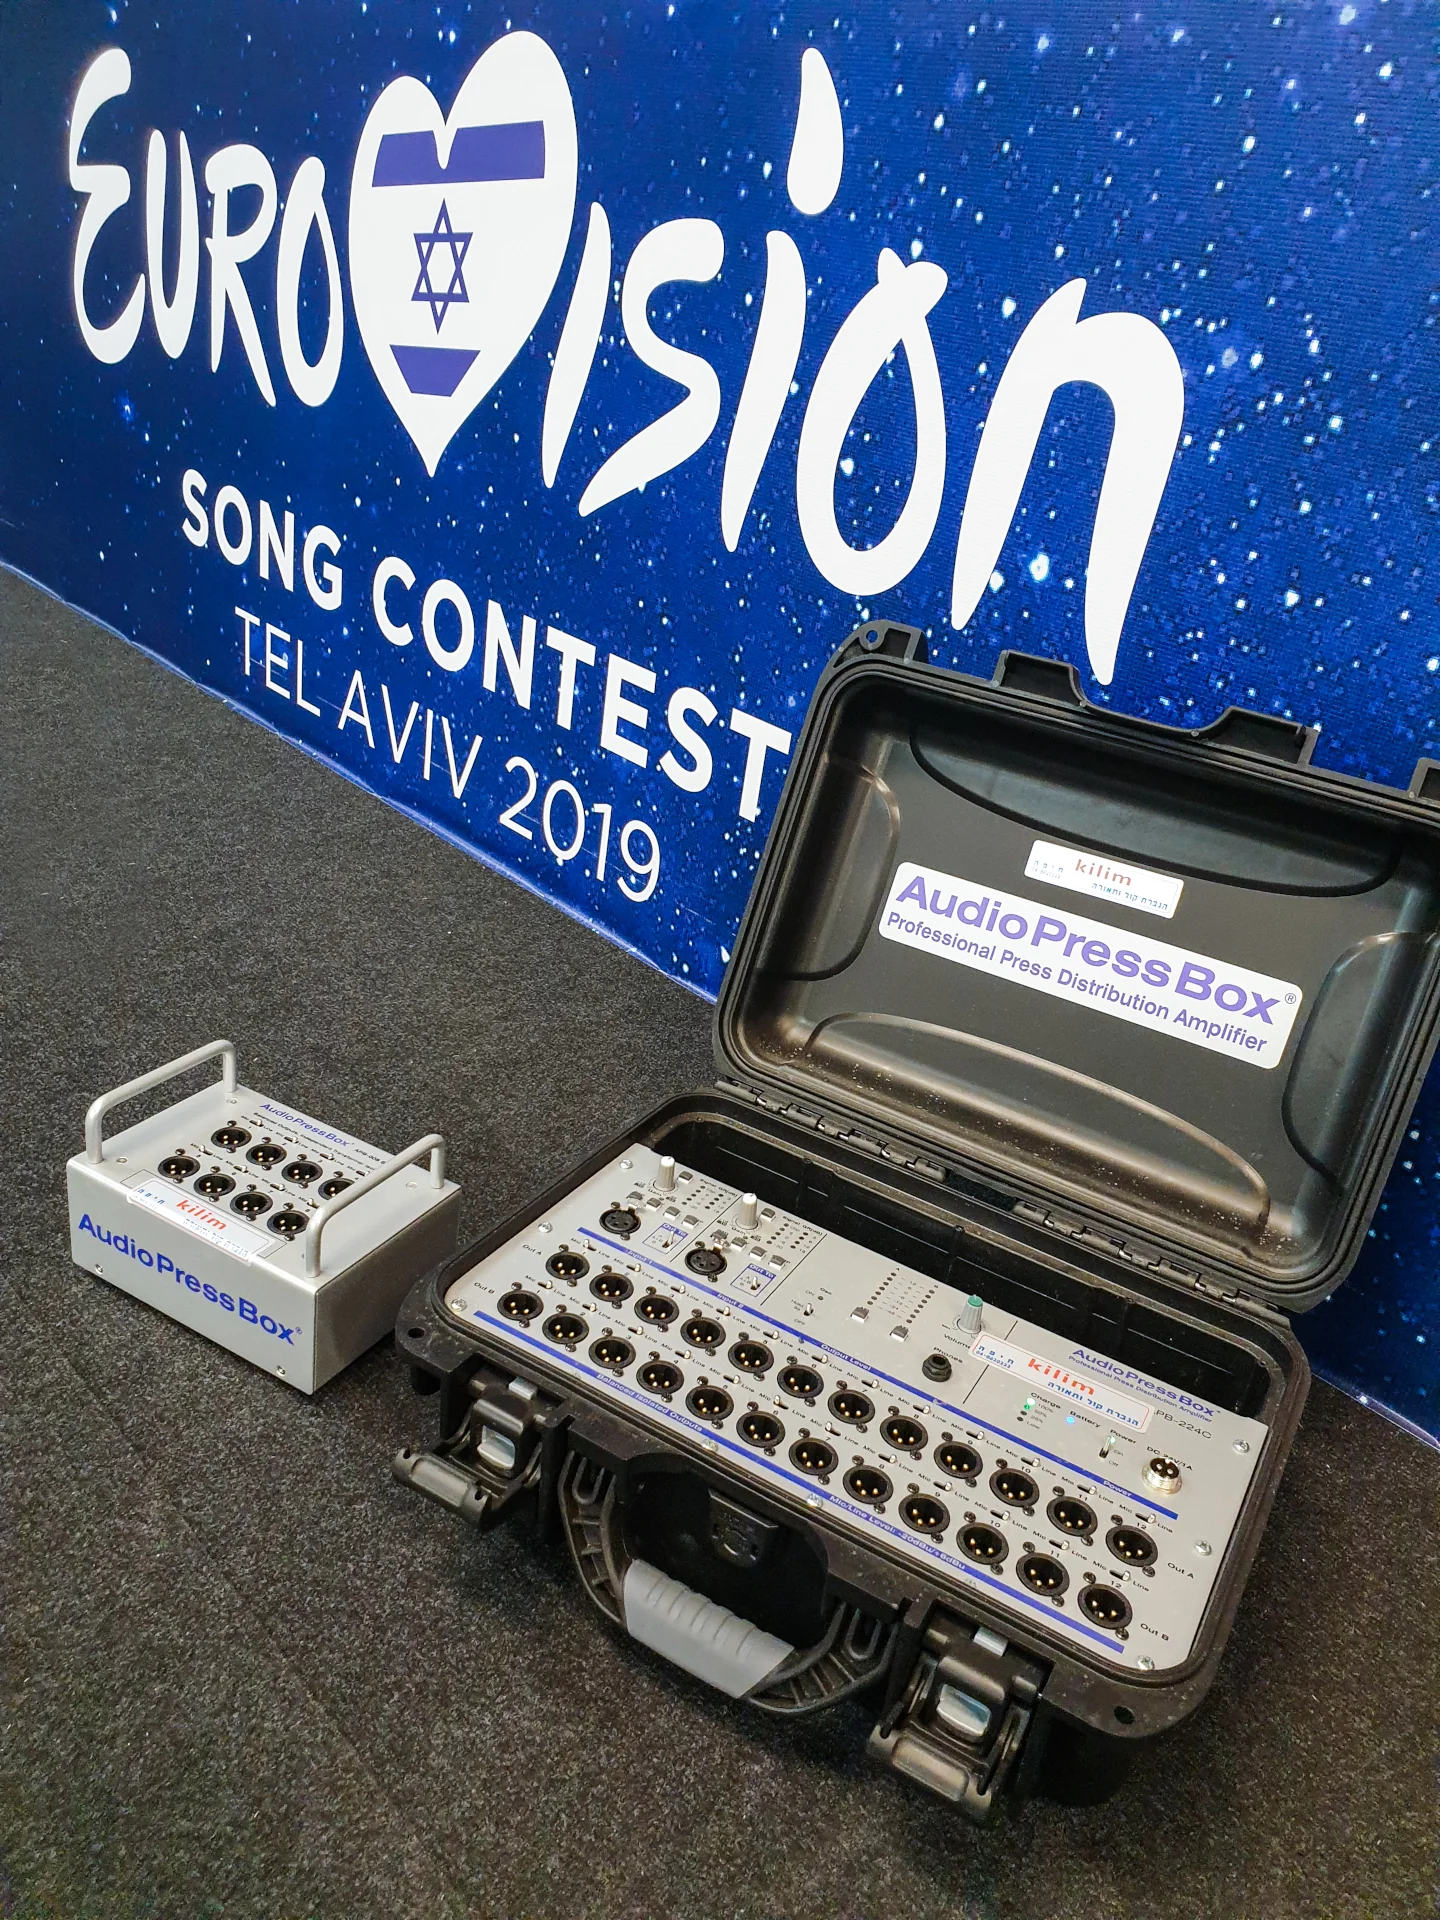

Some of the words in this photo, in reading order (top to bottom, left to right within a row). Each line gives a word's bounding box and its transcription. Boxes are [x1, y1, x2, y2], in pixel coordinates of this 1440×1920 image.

[181, 468, 342, 611] SONG
[373, 556, 792, 823] CONTEST
[235, 606, 321, 716] TEL
[338, 670, 482, 799] AVIV
[499, 756, 660, 903] 2019
[1075, 859, 1132, 886] kilim
[887, 912, 996, 961] Professional
[1000, 950, 1052, 980] Press
[1057, 968, 1170, 1020] Distribution
[1173, 1008, 1268, 1052] Amplifier
[176, 1199, 226, 1230] kilim
[522, 1244, 535, 1252] Out
[598, 1251, 610, 1259] Line
[524, 1275, 536, 1283] Mic
[474, 1282, 487, 1290] Out
[553, 1289, 566, 1297] Line
[687, 1293, 699, 1301] Line
[569, 1297, 581, 1305] Mic
[702, 1301, 714, 1309] Mic
[598, 1311, 611, 1320] Line
[733, 1316, 746, 1324] Line
[614, 1319, 626, 1327] Mic
[749, 1324, 761, 1332] Mic
[644, 1335, 658, 1343] Line
[661, 1343, 673, 1351] Mic
[780, 1340, 793, 1348] Line
[797, 1348, 809, 1356] Mic
[934, 1347, 963, 1363] Phones
[821, 1343, 849, 1361] Output
[850, 1357, 871, 1371] Level
[692, 1359, 706, 1368] Line
[829, 1364, 843, 1372] Line
[709, 1367, 721, 1375] Mic
[846, 1372, 859, 1380] Mic
[1028, 1358, 1095, 1395] kilim
[741, 1384, 755, 1393] Line
[880, 1388, 894, 1398] Line
[1068, 1355, 1112, 1381] Professional
[1113, 1376, 1134, 1388] Press
[1136, 1386, 1177, 1408] Distribution
[1179, 1406, 1212, 1423] Amplifier
[759, 1392, 771, 1401] Mic
[1031, 1392, 1061, 1409] Charge
[596, 1374, 634, 1398] Balanced
[635, 1392, 668, 1415] Isolated
[669, 1411, 703, 1432] Outputs
[898, 1397, 910, 1406] Mic
[1087, 1399, 1103, 1410] קול
[792, 1410, 806, 1419] Line
[932, 1414, 947, 1423] Line
[1070, 1410, 1101, 1428] Battery
[810, 1419, 822, 1427] Mic
[951, 1423, 964, 1432] Mic
[1154, 1409, 1212, 1440] PB-224C
[844, 1436, 859, 1445] Line
[1109, 1429, 1137, 1444] Power
[863, 1445, 876, 1454] Mic
[986, 1440, 1001, 1450] Line
[1005, 1449, 1019, 1458] Mic
[1146, 1446, 1160, 1455] DC
[898, 1463, 914, 1473] Line
[1041, 1467, 1057, 1476] Line
[918, 1473, 931, 1482] Mic
[1061, 1476, 1074, 1485] Mic
[1103, 1480, 1132, 1497] Power
[954, 1491, 970, 1502] Line
[1098, 1495, 1114, 1504] Line
[830, 1495, 868, 1518] Mic/Line
[974, 1501, 988, 1511] Mic
[1119, 1504, 1133, 1513] Mic
[1012, 1520, 1028, 1531] Line
[1157, 1523, 1173, 1533] Line
[1032, 1531, 1046, 1540] Mic
[1071, 1550, 1088, 1561] Line
[1093, 1560, 1107, 1571] Mic
[1167, 1562, 1185, 1574] Out
[1132, 1580, 1150, 1592] Line
[1140, 1622, 1159, 1637] Out
[1162, 1633, 1169, 1641] B
